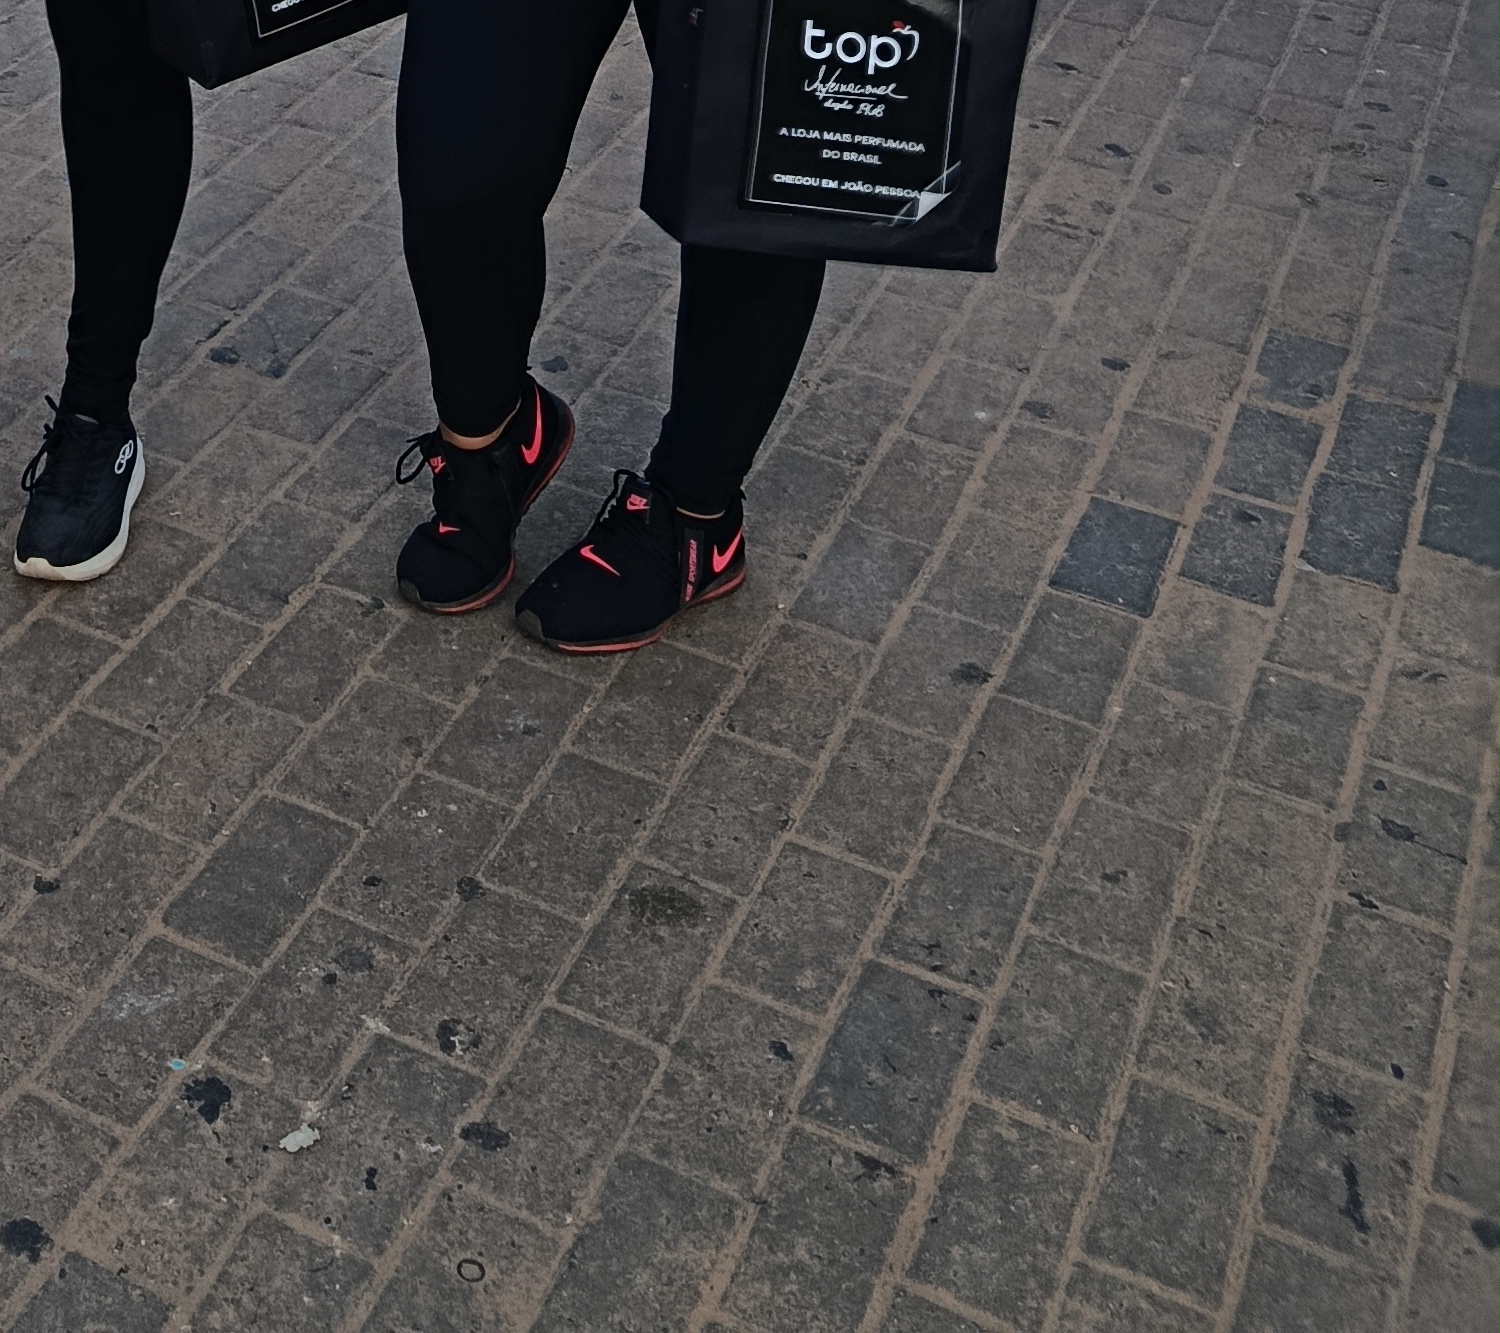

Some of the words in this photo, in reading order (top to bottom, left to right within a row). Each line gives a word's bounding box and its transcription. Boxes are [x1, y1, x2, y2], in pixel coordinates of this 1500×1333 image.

[803, 19, 901, 75] top
[779, 127, 789, 137] A
[791, 127, 821, 140] LOJA
[823, 131, 853, 143] MAIS
[854, 133, 926, 153] PERFUMADA
[822, 148, 841, 160] DO
[842, 151, 882, 165] BRASIL
[773, 172, 820, 187] CHEGOU
[821, 178, 839, 189] EM
[840, 180, 873, 194] JOÃO
[874, 184, 921, 199] PESSOA
